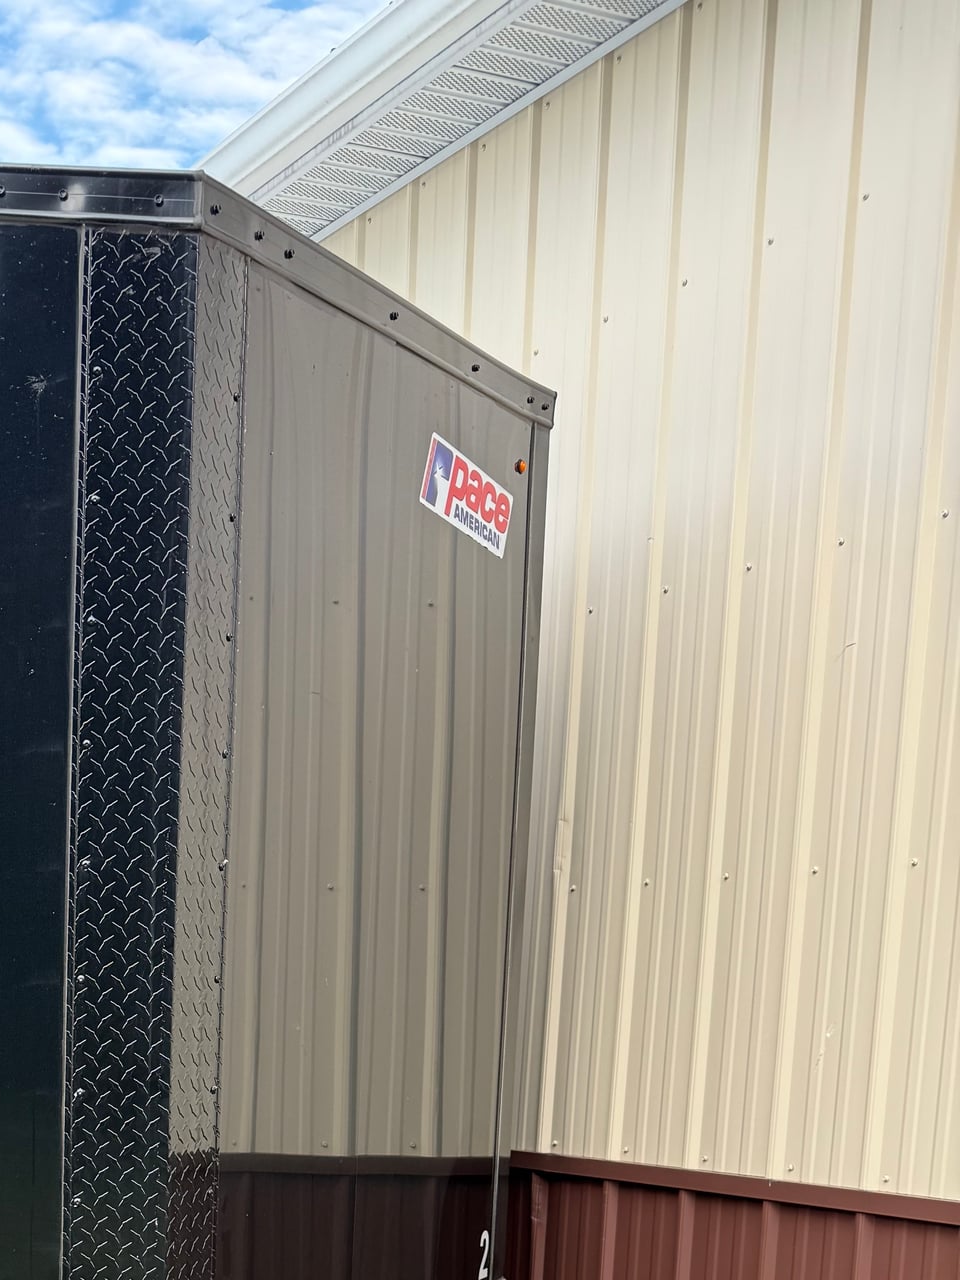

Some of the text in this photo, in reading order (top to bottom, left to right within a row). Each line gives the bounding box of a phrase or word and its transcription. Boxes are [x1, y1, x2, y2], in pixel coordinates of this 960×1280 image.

[444, 455, 510, 534] pace
[453, 504, 500, 550] AMERICAN
[478, 1230, 490, 1280] 2
